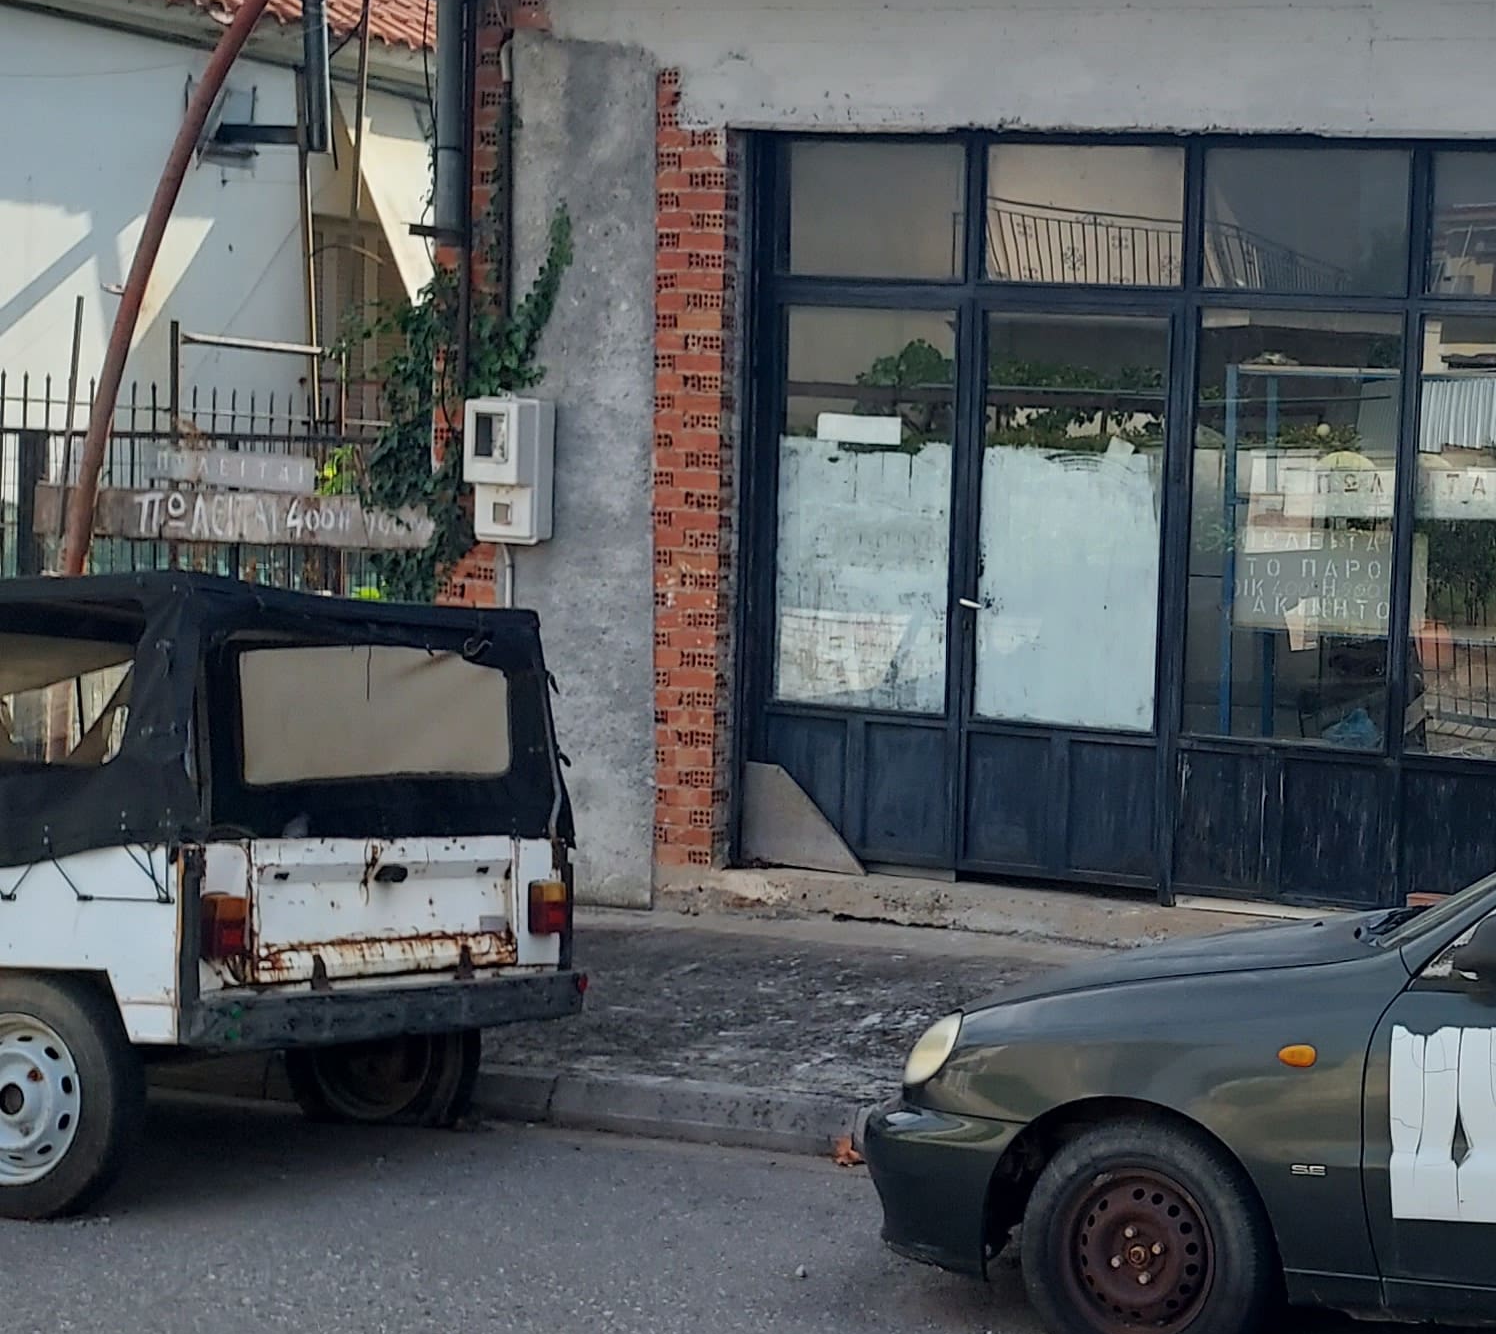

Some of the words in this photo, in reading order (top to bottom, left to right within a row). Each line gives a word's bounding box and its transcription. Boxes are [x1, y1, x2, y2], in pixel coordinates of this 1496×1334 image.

[1246, 557, 1281, 577] ΤΟ
[1302, 558, 1392, 579] ΠΑΡΟ
[1291, 1164, 1326, 1176] SE
